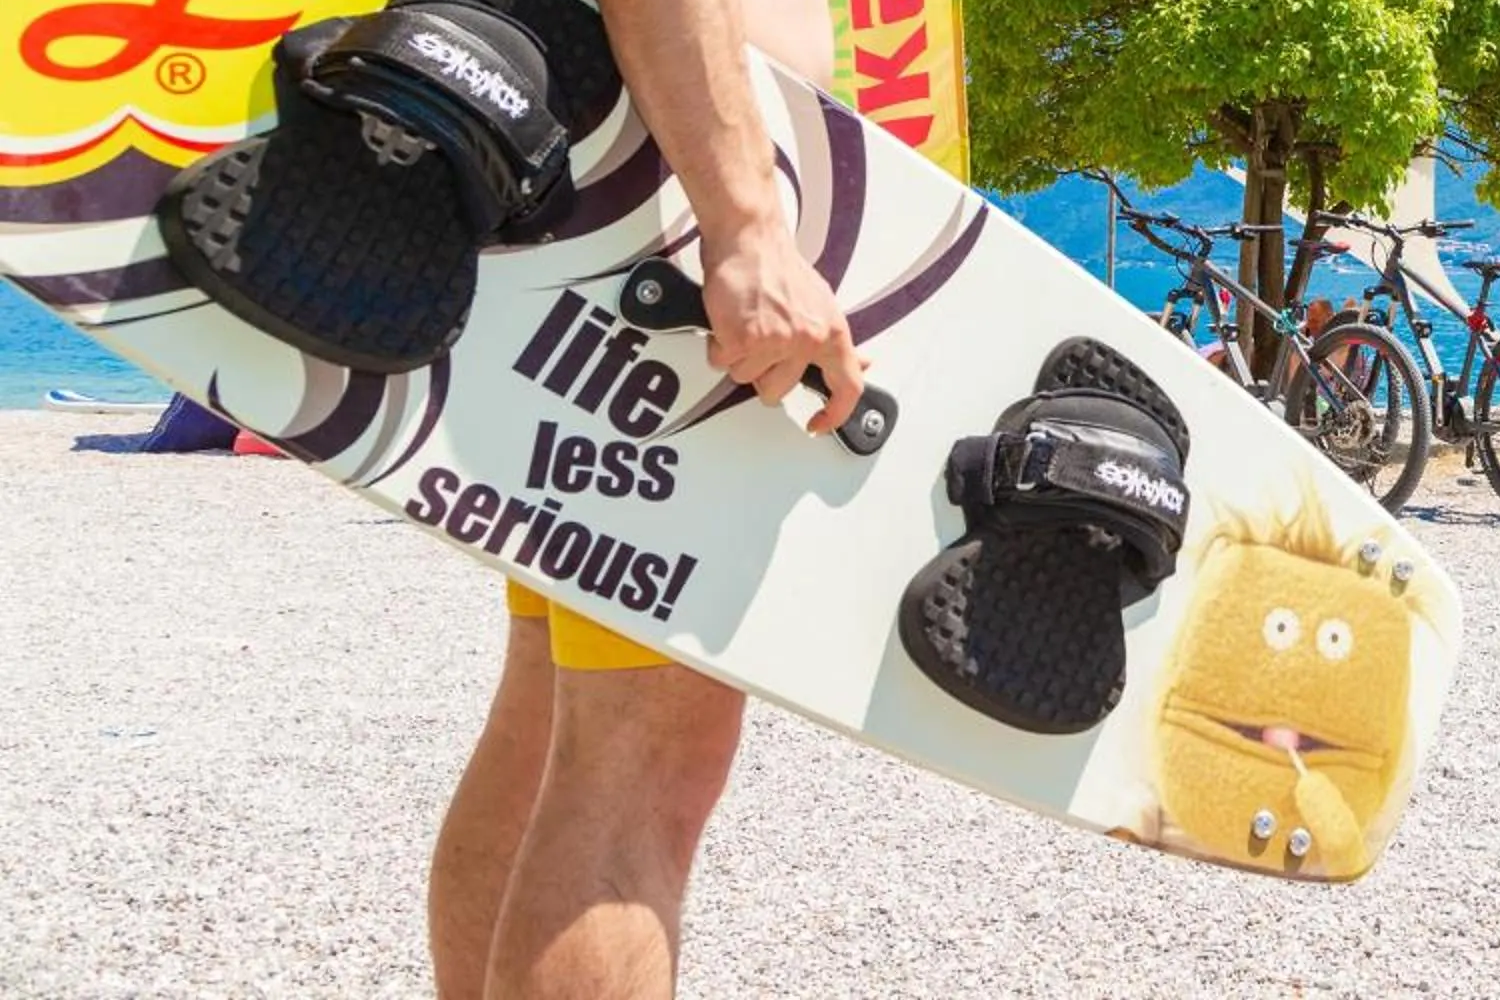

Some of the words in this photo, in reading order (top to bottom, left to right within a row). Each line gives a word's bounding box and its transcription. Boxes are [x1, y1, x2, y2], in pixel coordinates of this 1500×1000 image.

[511, 287, 682, 440] life
[525, 420, 681, 503] less
[403, 466, 699, 622] serious!
